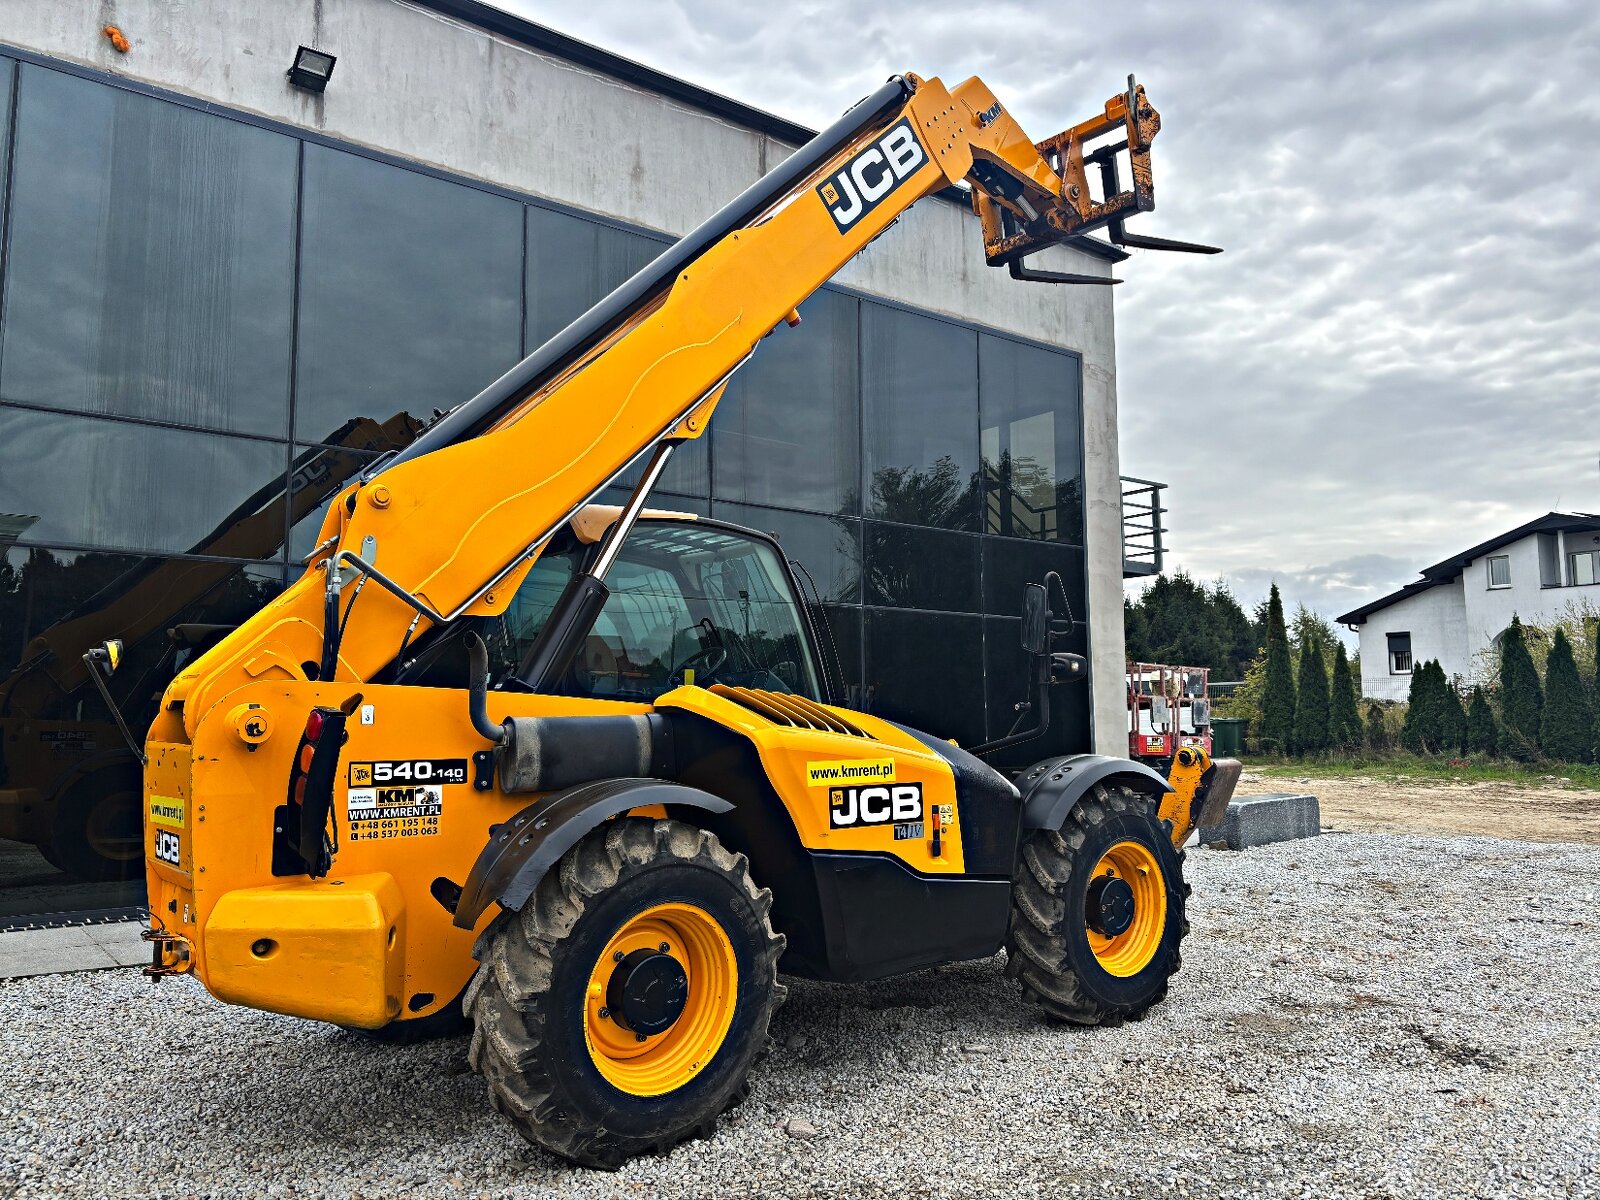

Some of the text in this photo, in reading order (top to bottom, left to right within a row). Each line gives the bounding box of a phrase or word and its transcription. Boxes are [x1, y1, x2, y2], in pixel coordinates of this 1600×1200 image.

[833, 125, 923, 225] JCB
[810, 763, 893, 779] www.kmrent.pl
[379, 789, 414, 803] KM
[349, 806, 440, 820] WWW.KMRENT.PL
[832, 786, 921, 825] JCB
[361, 821, 378, 830] +48
[382, 820, 398, 828] 661
[402, 819, 418, 827] 195
[360, 826, 438, 840] +48 537 003 063
[155, 831, 179, 863] JCB
